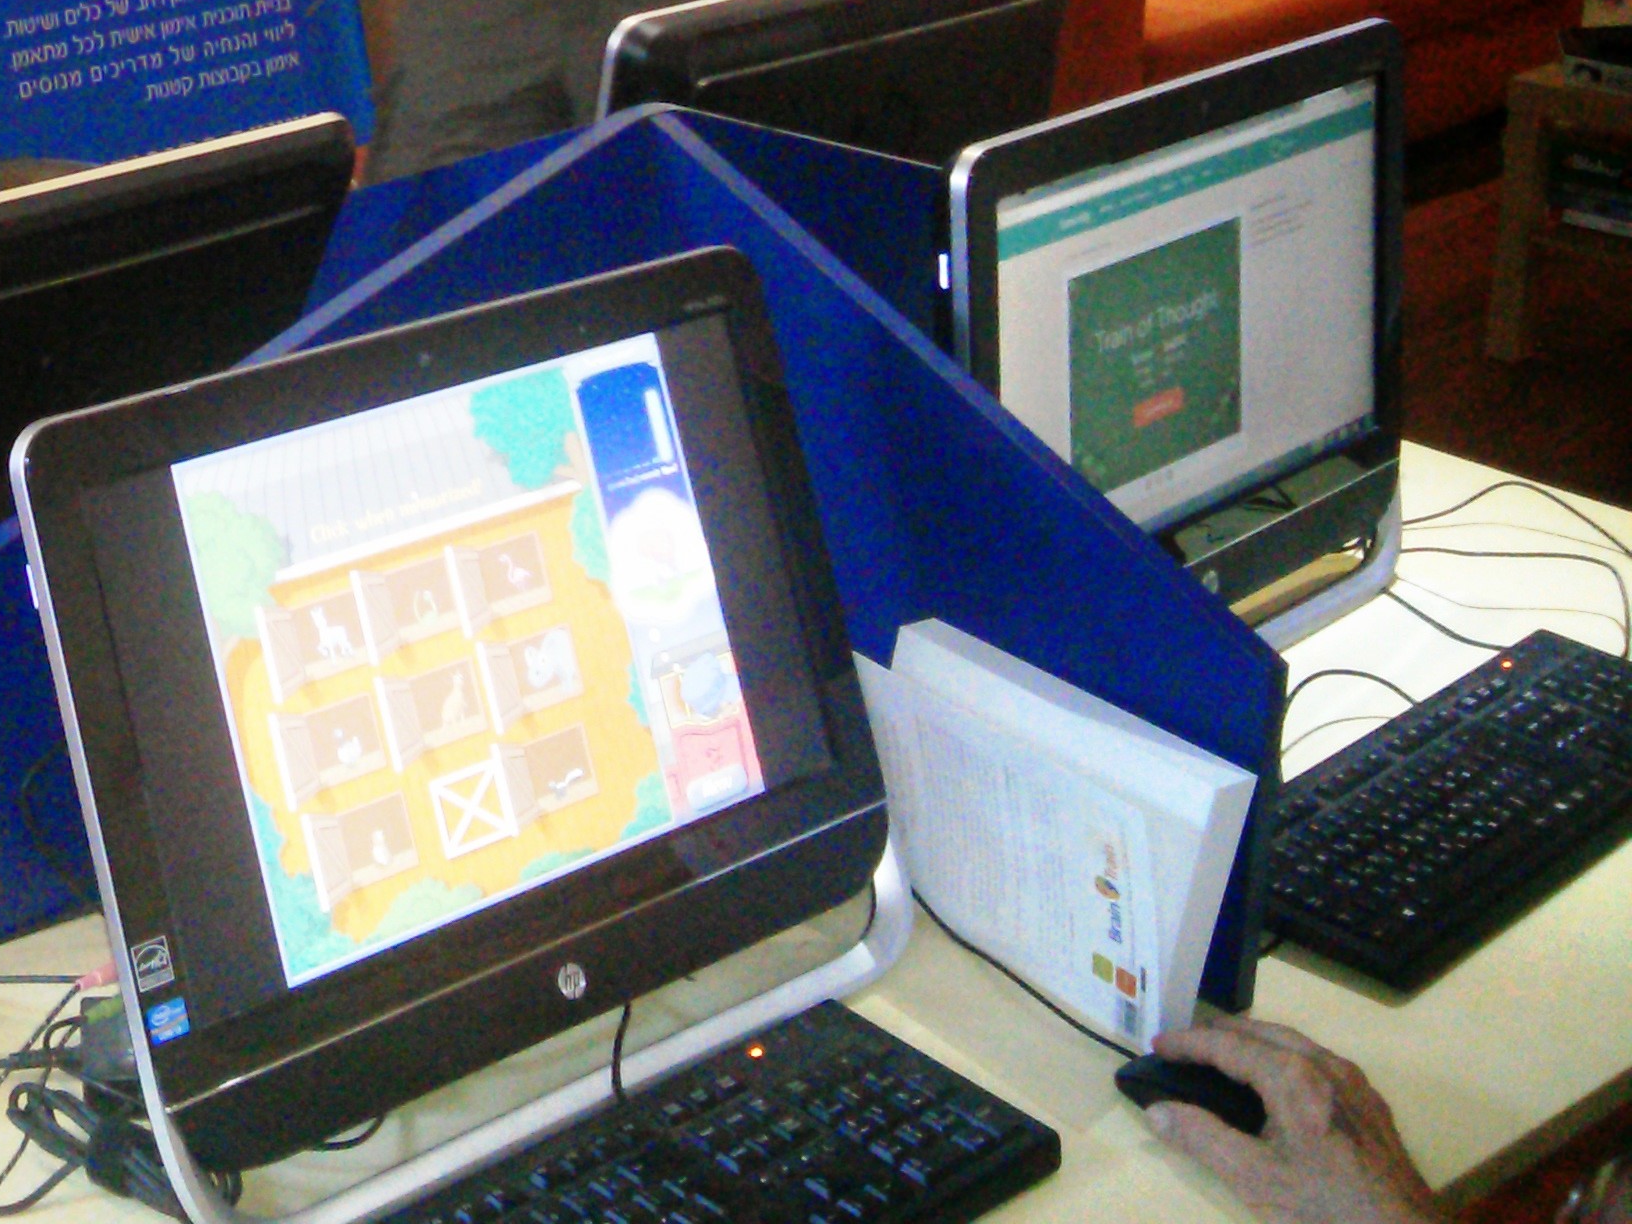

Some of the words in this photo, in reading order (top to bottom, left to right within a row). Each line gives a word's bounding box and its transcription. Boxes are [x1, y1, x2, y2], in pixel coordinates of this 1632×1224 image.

[64, 2, 101, 26] כלים
[201, 3, 250, 29] תוכנית
[110, 24, 156, 50] אישית
[161, 16, 196, 41] אימון
[264, 20, 296, 43] ליווי
[72, 30, 105, 56] לכל
[169, 44, 195, 66] של
[203, 28, 257, 59] והנחיה
[90, 51, 162, 83] מדריכים
[199, 60, 261, 89] בקבוצות
[265, 51, 300, 76] אימון
